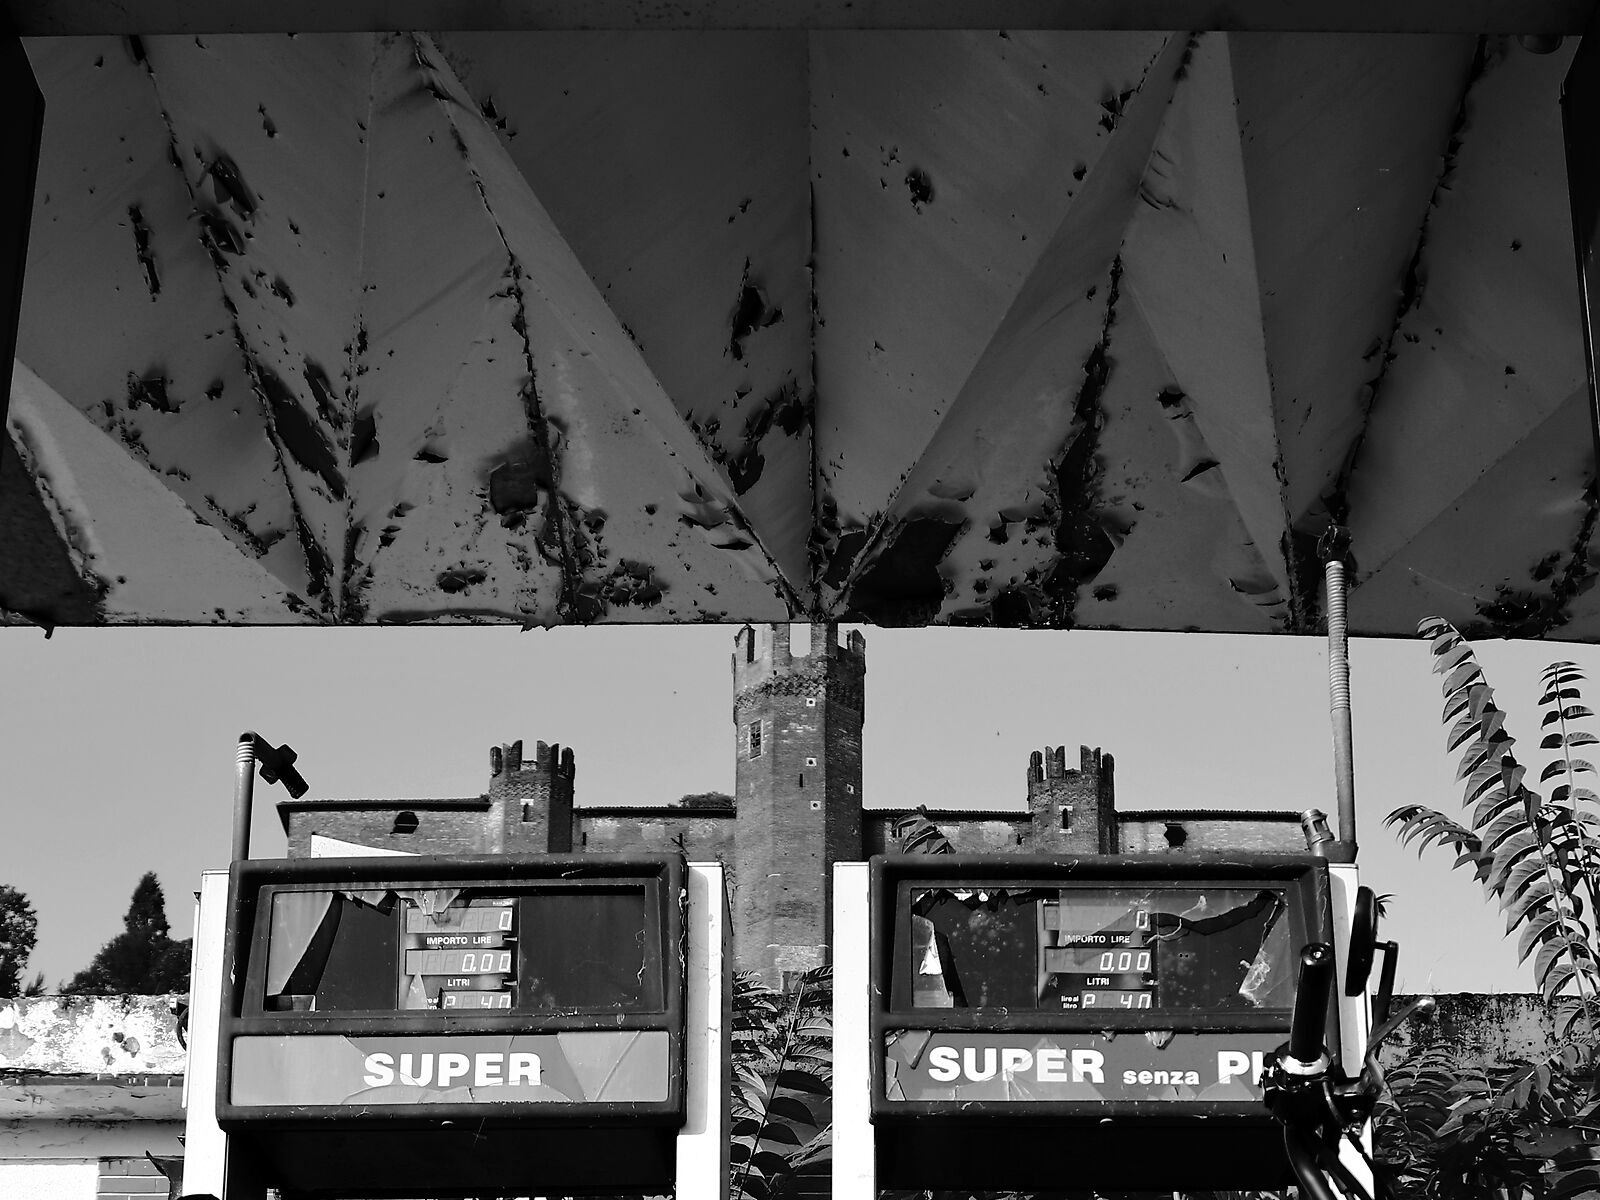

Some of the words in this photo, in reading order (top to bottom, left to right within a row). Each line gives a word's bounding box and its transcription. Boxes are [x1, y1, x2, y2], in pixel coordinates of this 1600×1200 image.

[499, 911, 513, 930] 0
[1135, 910, 1149, 928] 0
[426, 936, 468, 945] IMPORTO
[472, 935, 492, 944] LIRE
[1064, 934, 1107, 943] IMPORTO
[1110, 934, 1131, 943] LIRE
[1099, 952, 1150, 972] 0,00
[447, 979, 470, 987] LITRI
[1086, 977, 1110, 986] LITRI
[363, 1052, 541, 1087] SUPER
[928, 1046, 1105, 1083] SUPER
[1123, 1069, 1199, 1085] senza
